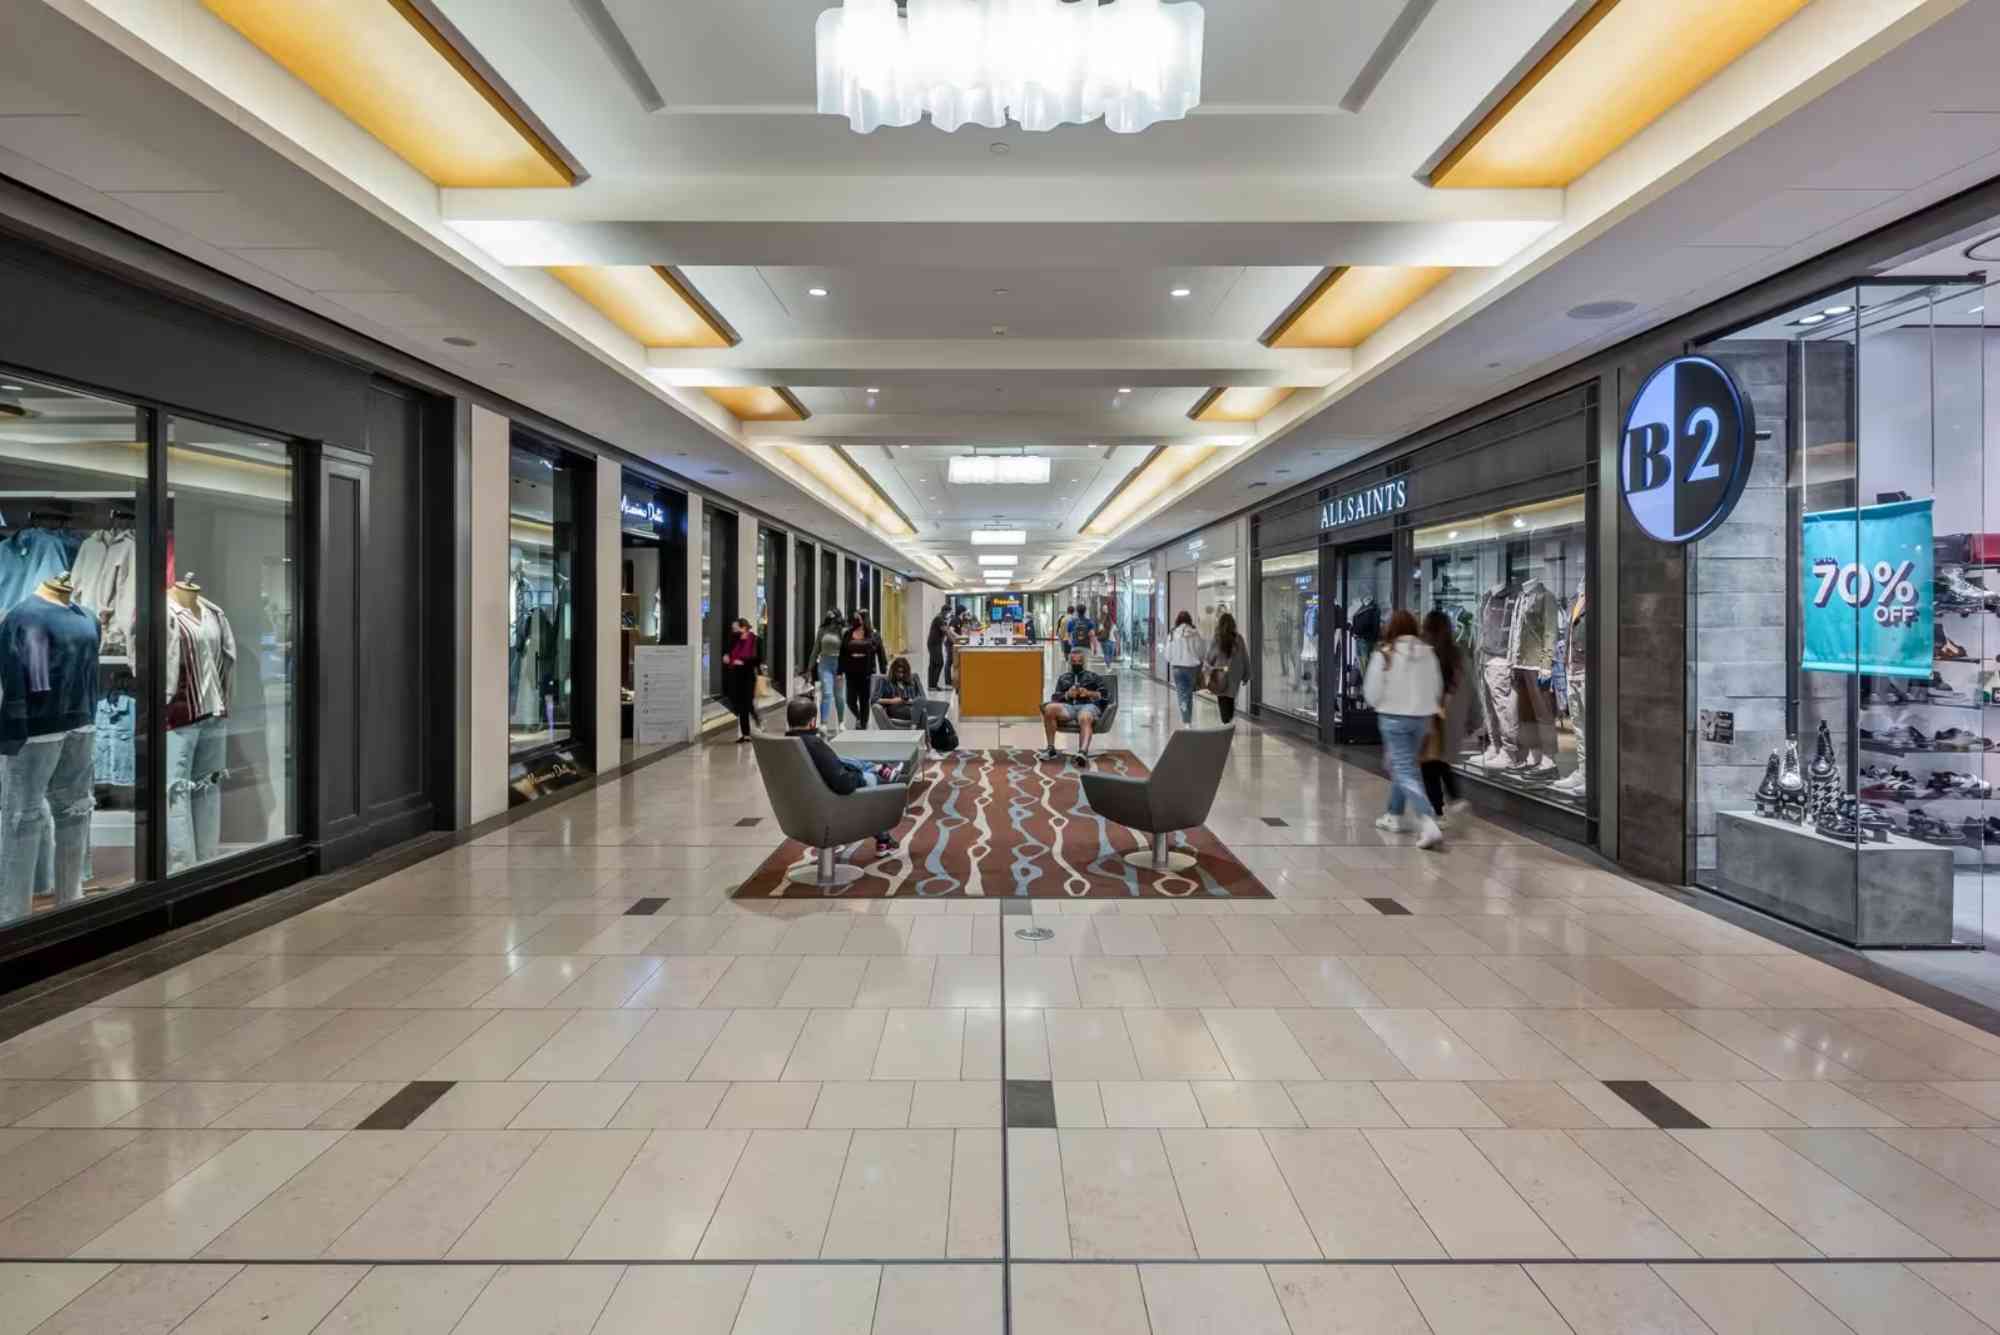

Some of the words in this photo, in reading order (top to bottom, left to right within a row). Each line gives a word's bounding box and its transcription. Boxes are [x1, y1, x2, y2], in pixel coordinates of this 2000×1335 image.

[1623, 406, 1720, 495] B2
[1320, 480, 1406, 529] ALLSAINTS
[1812, 560, 1917, 608] 70%
[1873, 606, 1918, 625] OFF
